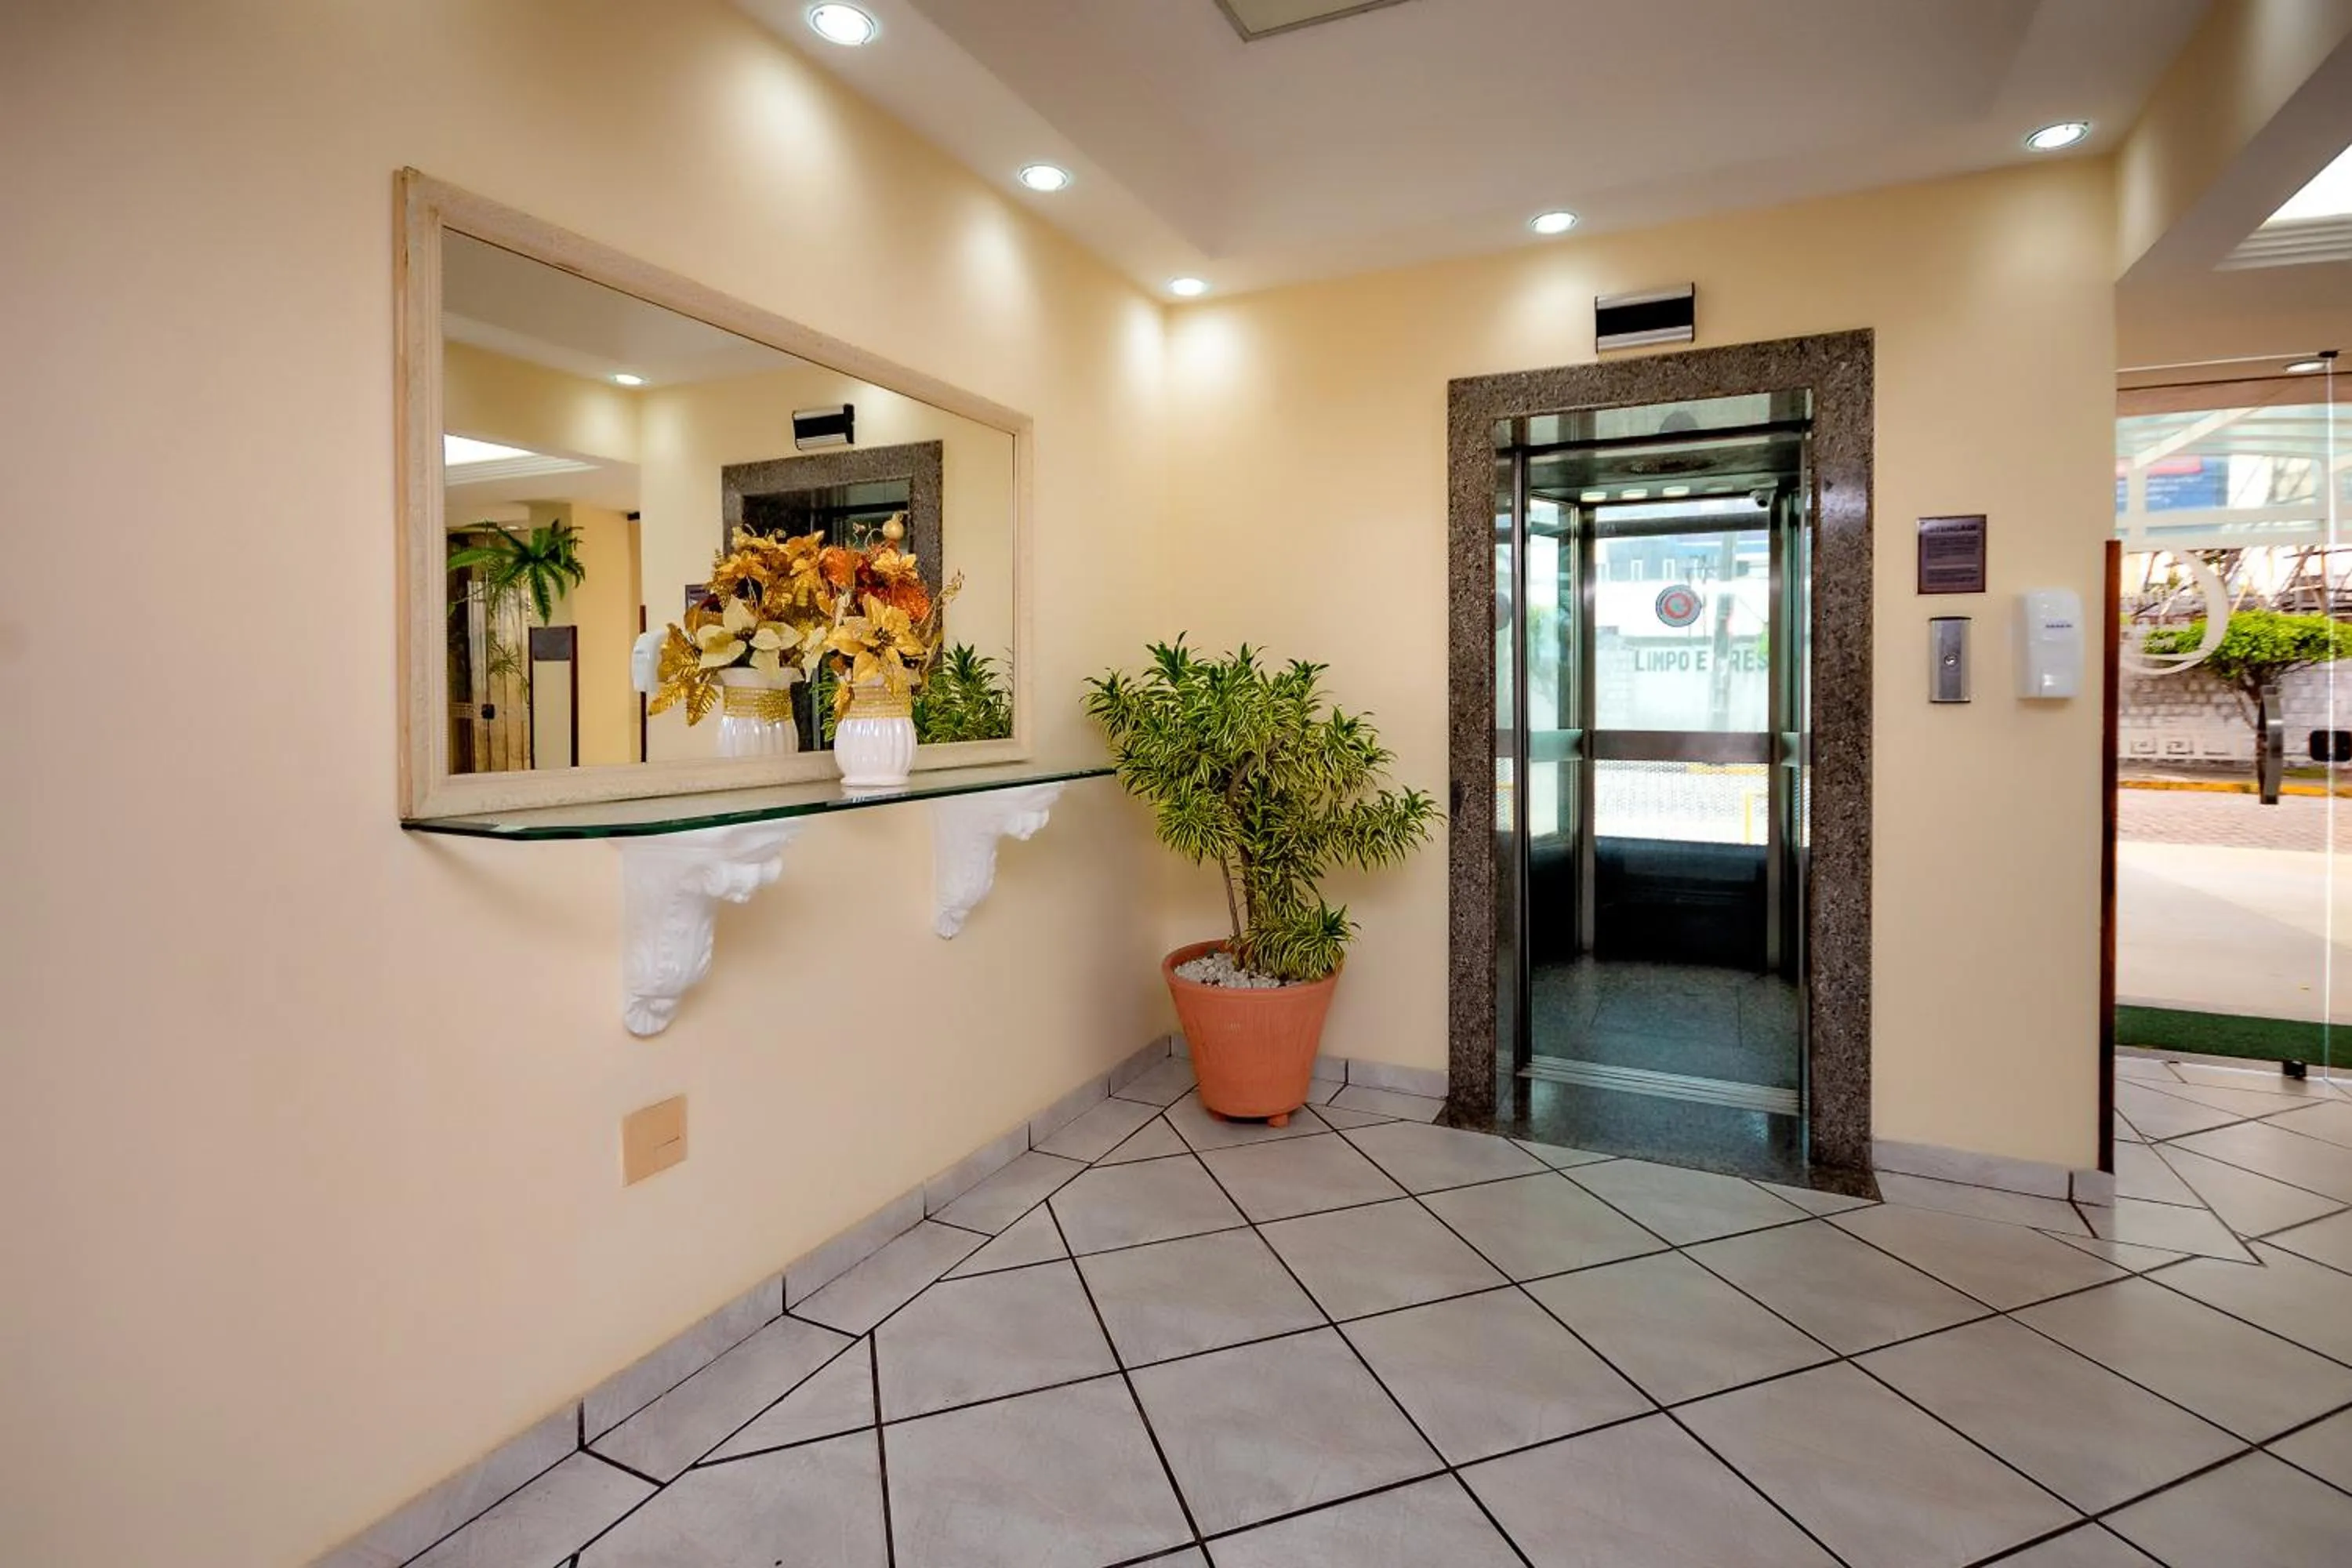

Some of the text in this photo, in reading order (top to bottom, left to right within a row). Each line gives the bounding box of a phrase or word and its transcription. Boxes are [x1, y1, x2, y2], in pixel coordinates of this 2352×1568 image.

[1635, 649, 1768, 673] LIMPO E RES
